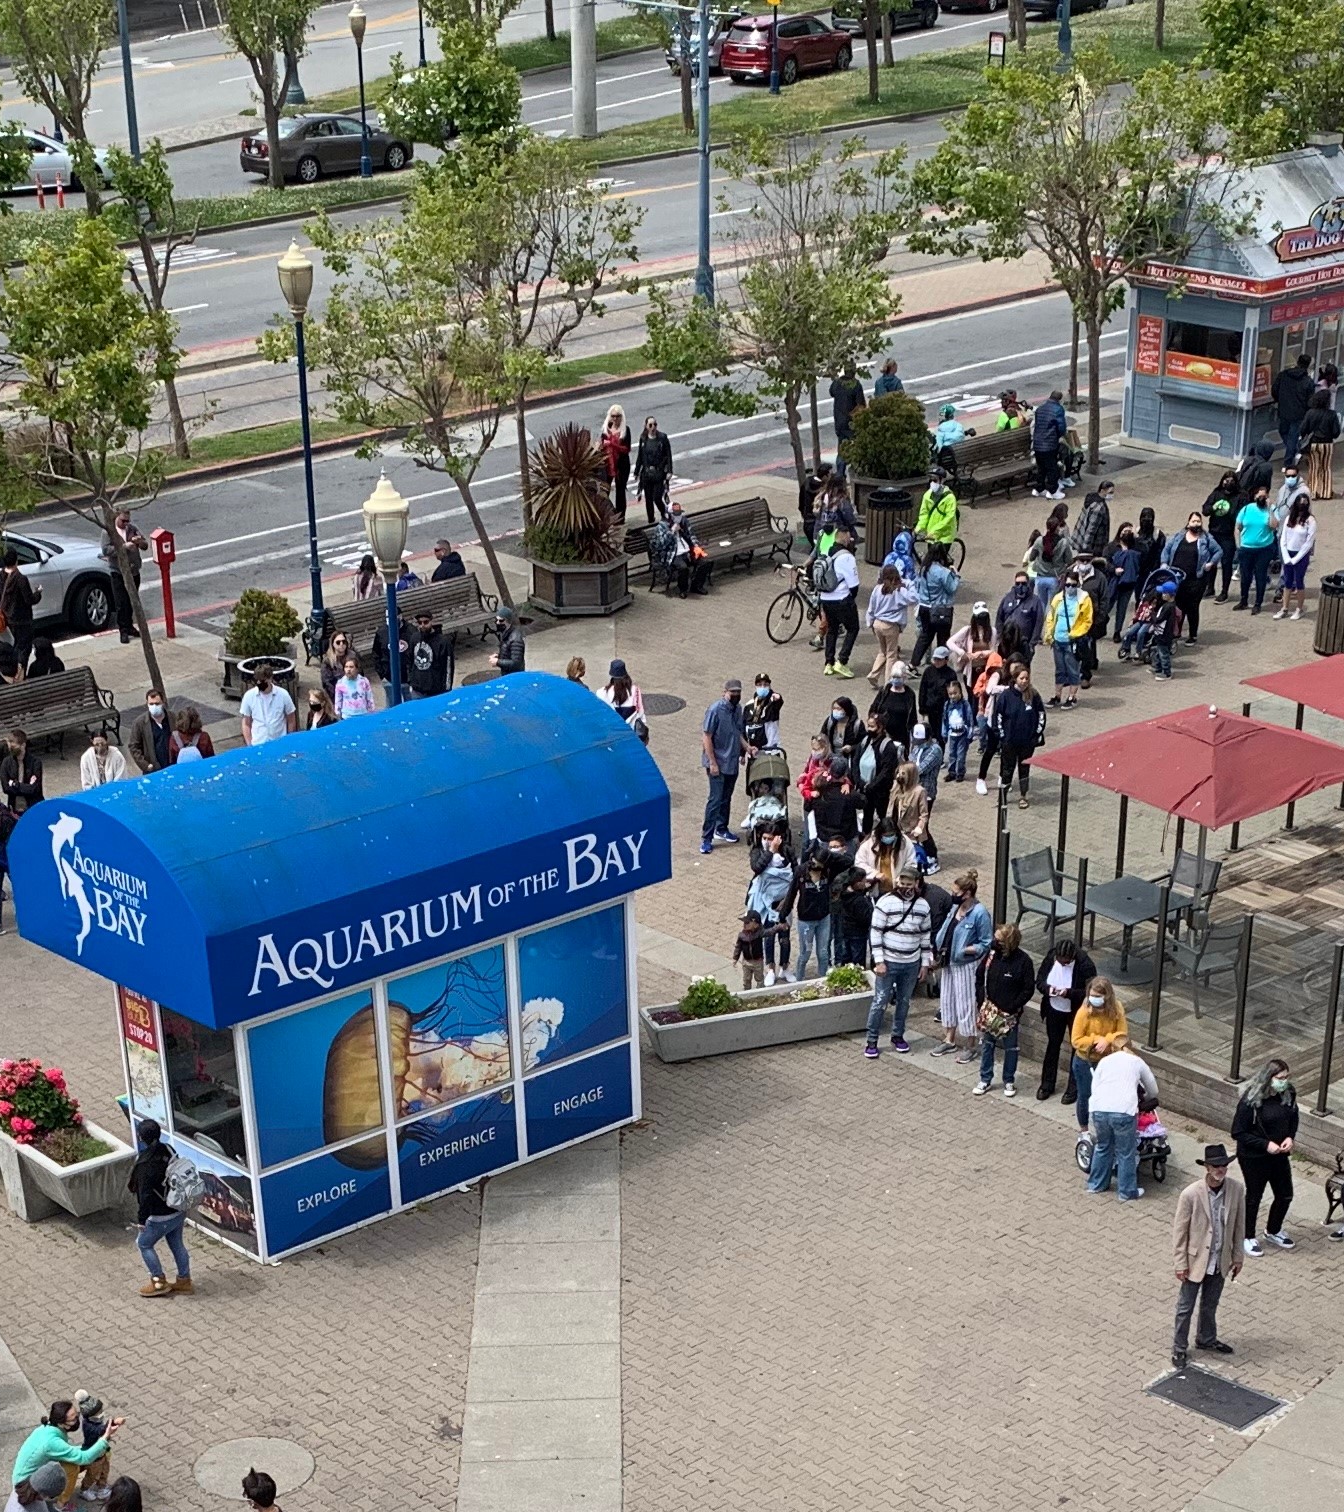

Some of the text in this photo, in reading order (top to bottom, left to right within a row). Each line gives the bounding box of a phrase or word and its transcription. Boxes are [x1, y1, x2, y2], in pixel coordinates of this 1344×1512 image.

[1289, 238, 1314, 254] THE
[1314, 232, 1341, 248] DOG
[1317, 268, 1331, 280] HOT
[73, 845, 148, 900] AQUARIUM
[93, 887, 148, 946] BAY
[112, 889, 141, 909] OF THE
[247, 828, 649, 997] AQUARIUM OF THE BAY
[553, 1085, 605, 1116] ENGAGE
[419, 1126, 497, 1167] EXPERIENCE
[297, 1178, 357, 1214] EXPLORE
